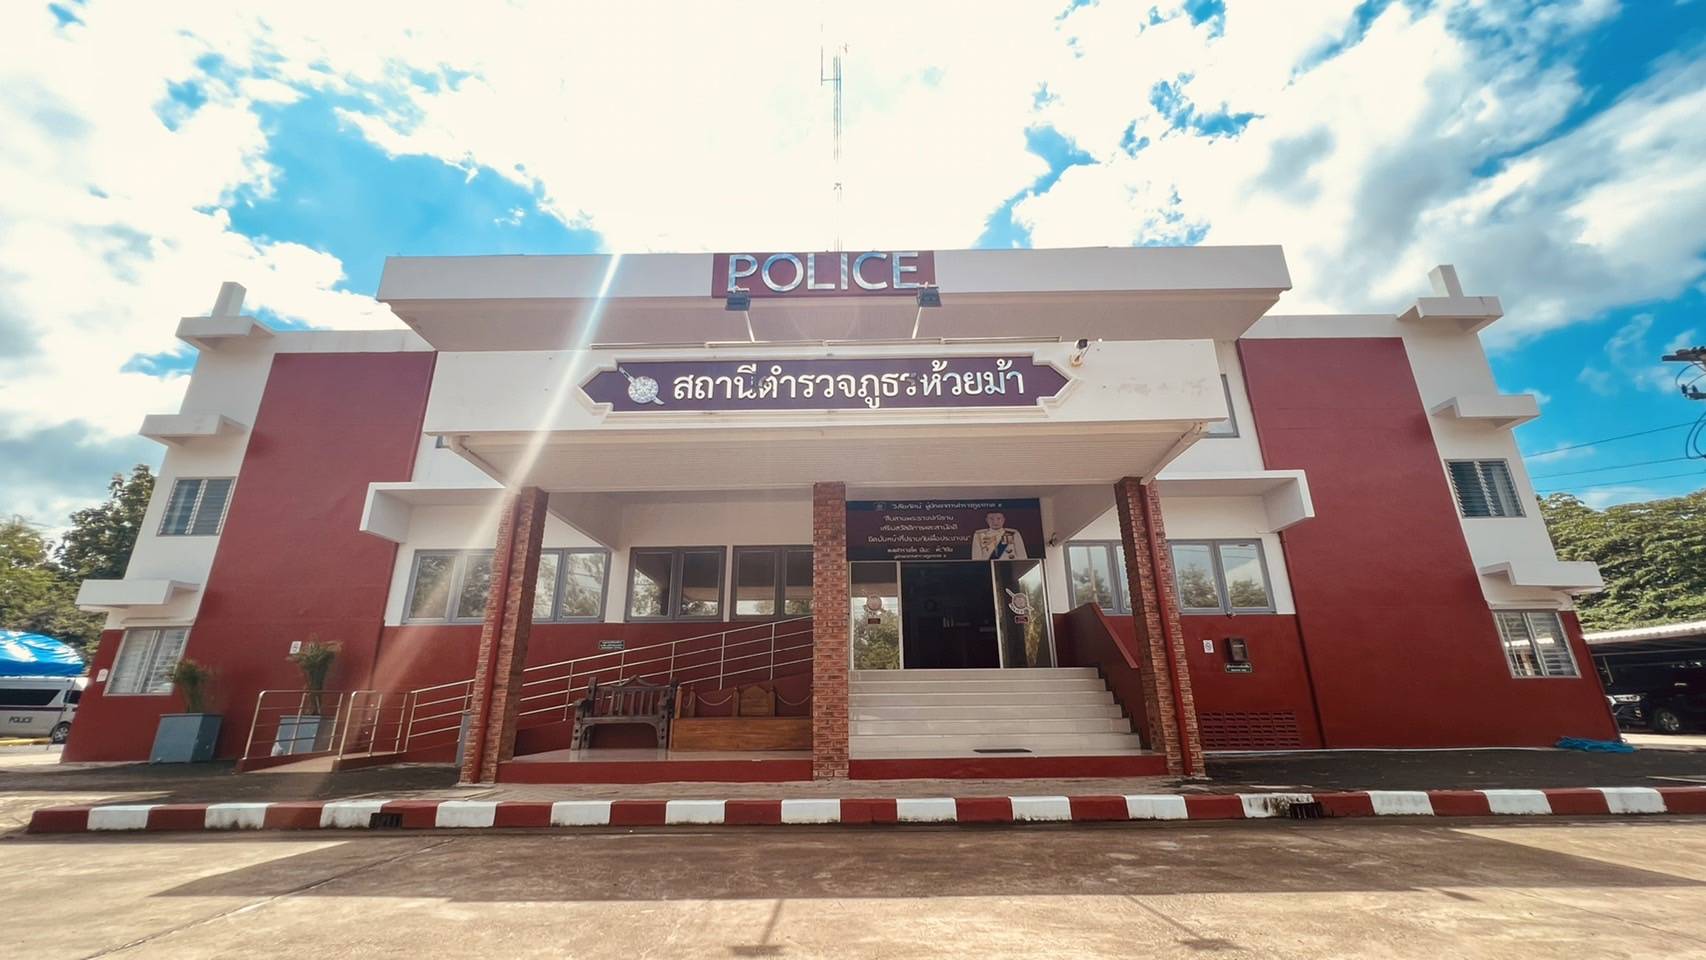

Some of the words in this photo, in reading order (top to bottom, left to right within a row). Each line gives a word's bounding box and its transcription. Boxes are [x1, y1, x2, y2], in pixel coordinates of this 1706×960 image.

[727, 252, 921, 292] POLICE
[673, 358, 1024, 409] สถานีตำรวจภูธรห้วยม้า
